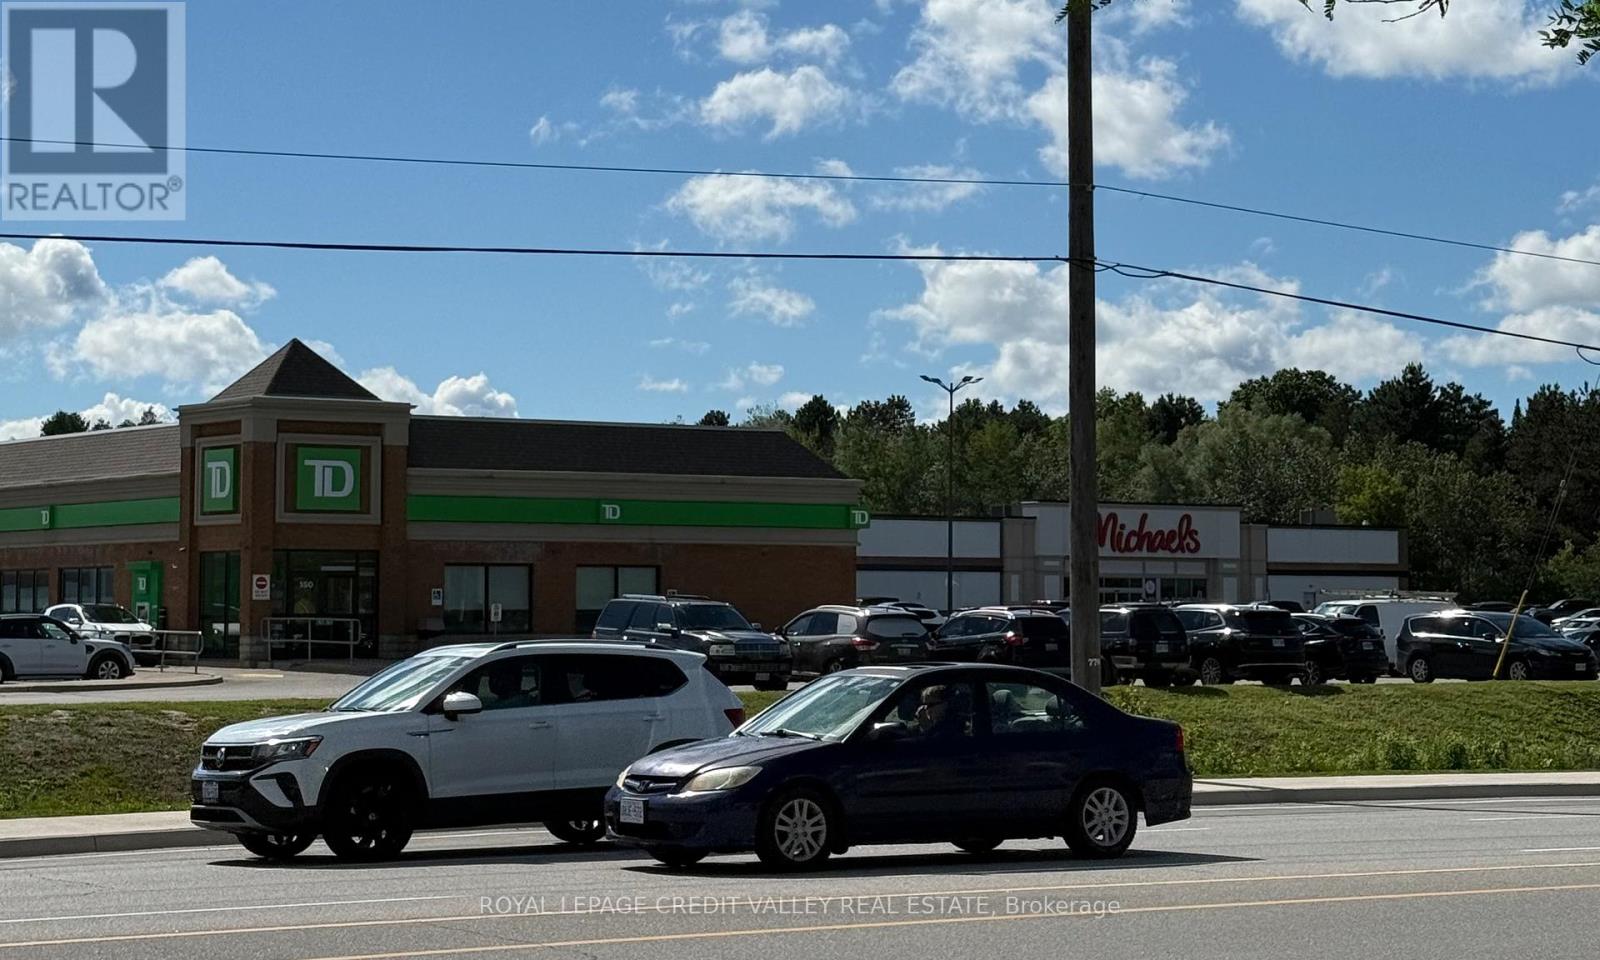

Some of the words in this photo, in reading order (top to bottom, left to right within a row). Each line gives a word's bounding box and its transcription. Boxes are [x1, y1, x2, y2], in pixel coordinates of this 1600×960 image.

[207, 460, 231, 498] TD
[304, 459, 354, 498] TD
[41, 510, 50, 525] TD
[601, 504, 621, 520] TD
[851, 510, 869, 525] TD
[137, 577, 147, 591] TD
